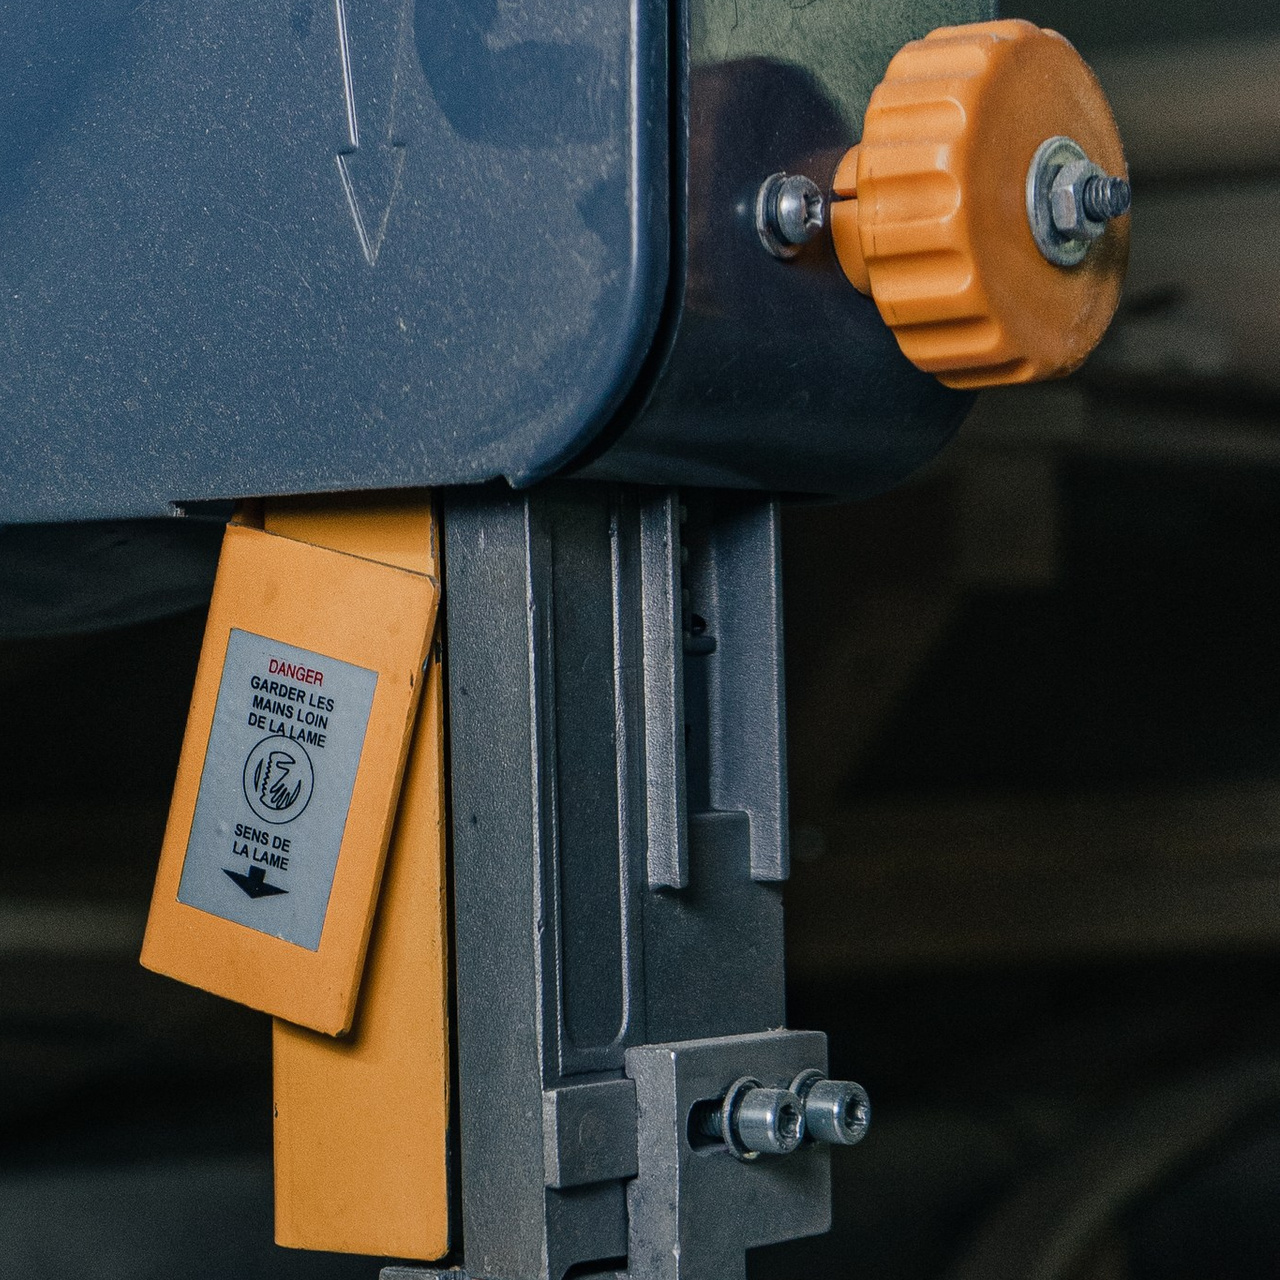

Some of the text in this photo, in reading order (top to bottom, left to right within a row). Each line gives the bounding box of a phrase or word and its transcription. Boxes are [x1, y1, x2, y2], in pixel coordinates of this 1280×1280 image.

[268, 658, 324, 687] DANGER
[250, 675, 335, 713] GARDER LES
[252, 694, 329, 730] MAINS LOIN
[247, 713, 327, 748] DE LA LAME
[234, 823, 291, 853] SENS DE
[232, 840, 289, 871] LA LAME
